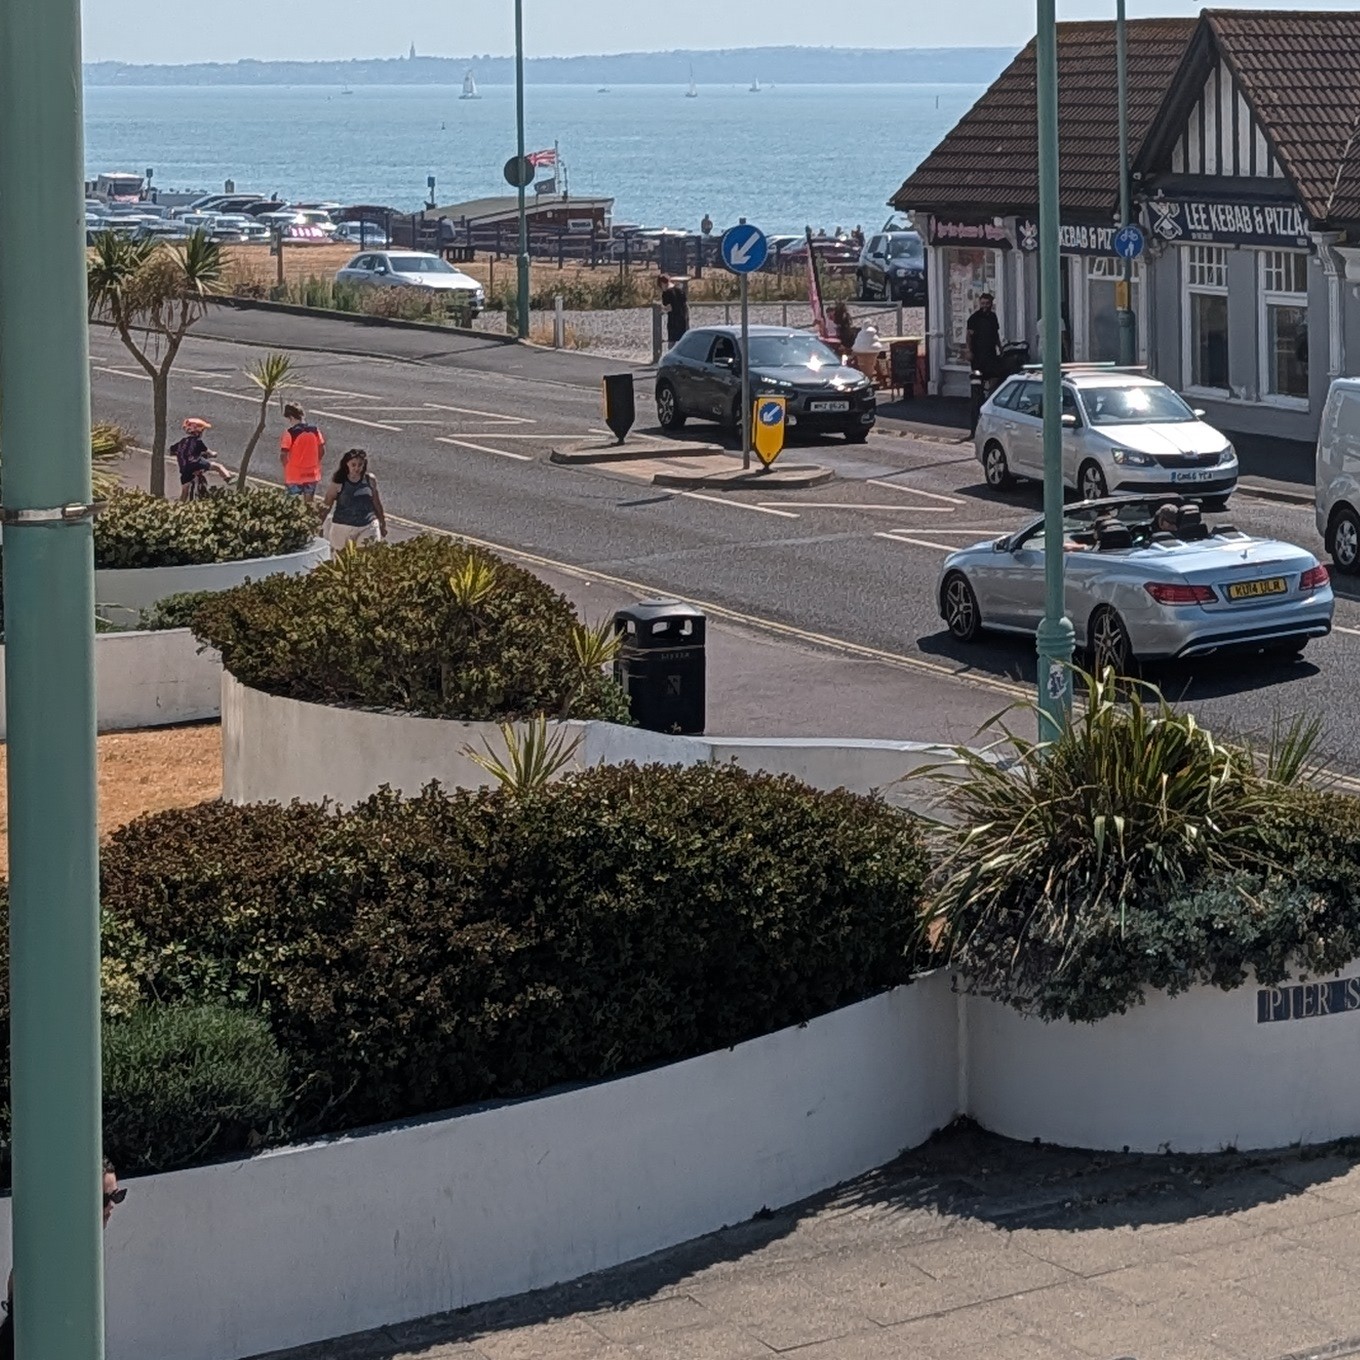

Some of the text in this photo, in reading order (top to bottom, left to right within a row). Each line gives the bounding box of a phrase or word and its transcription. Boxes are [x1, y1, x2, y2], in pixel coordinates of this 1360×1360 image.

[1185, 202, 1306, 236] LEE KEBAB & PIZZA
[1268, 983, 1331, 1021] PIER
